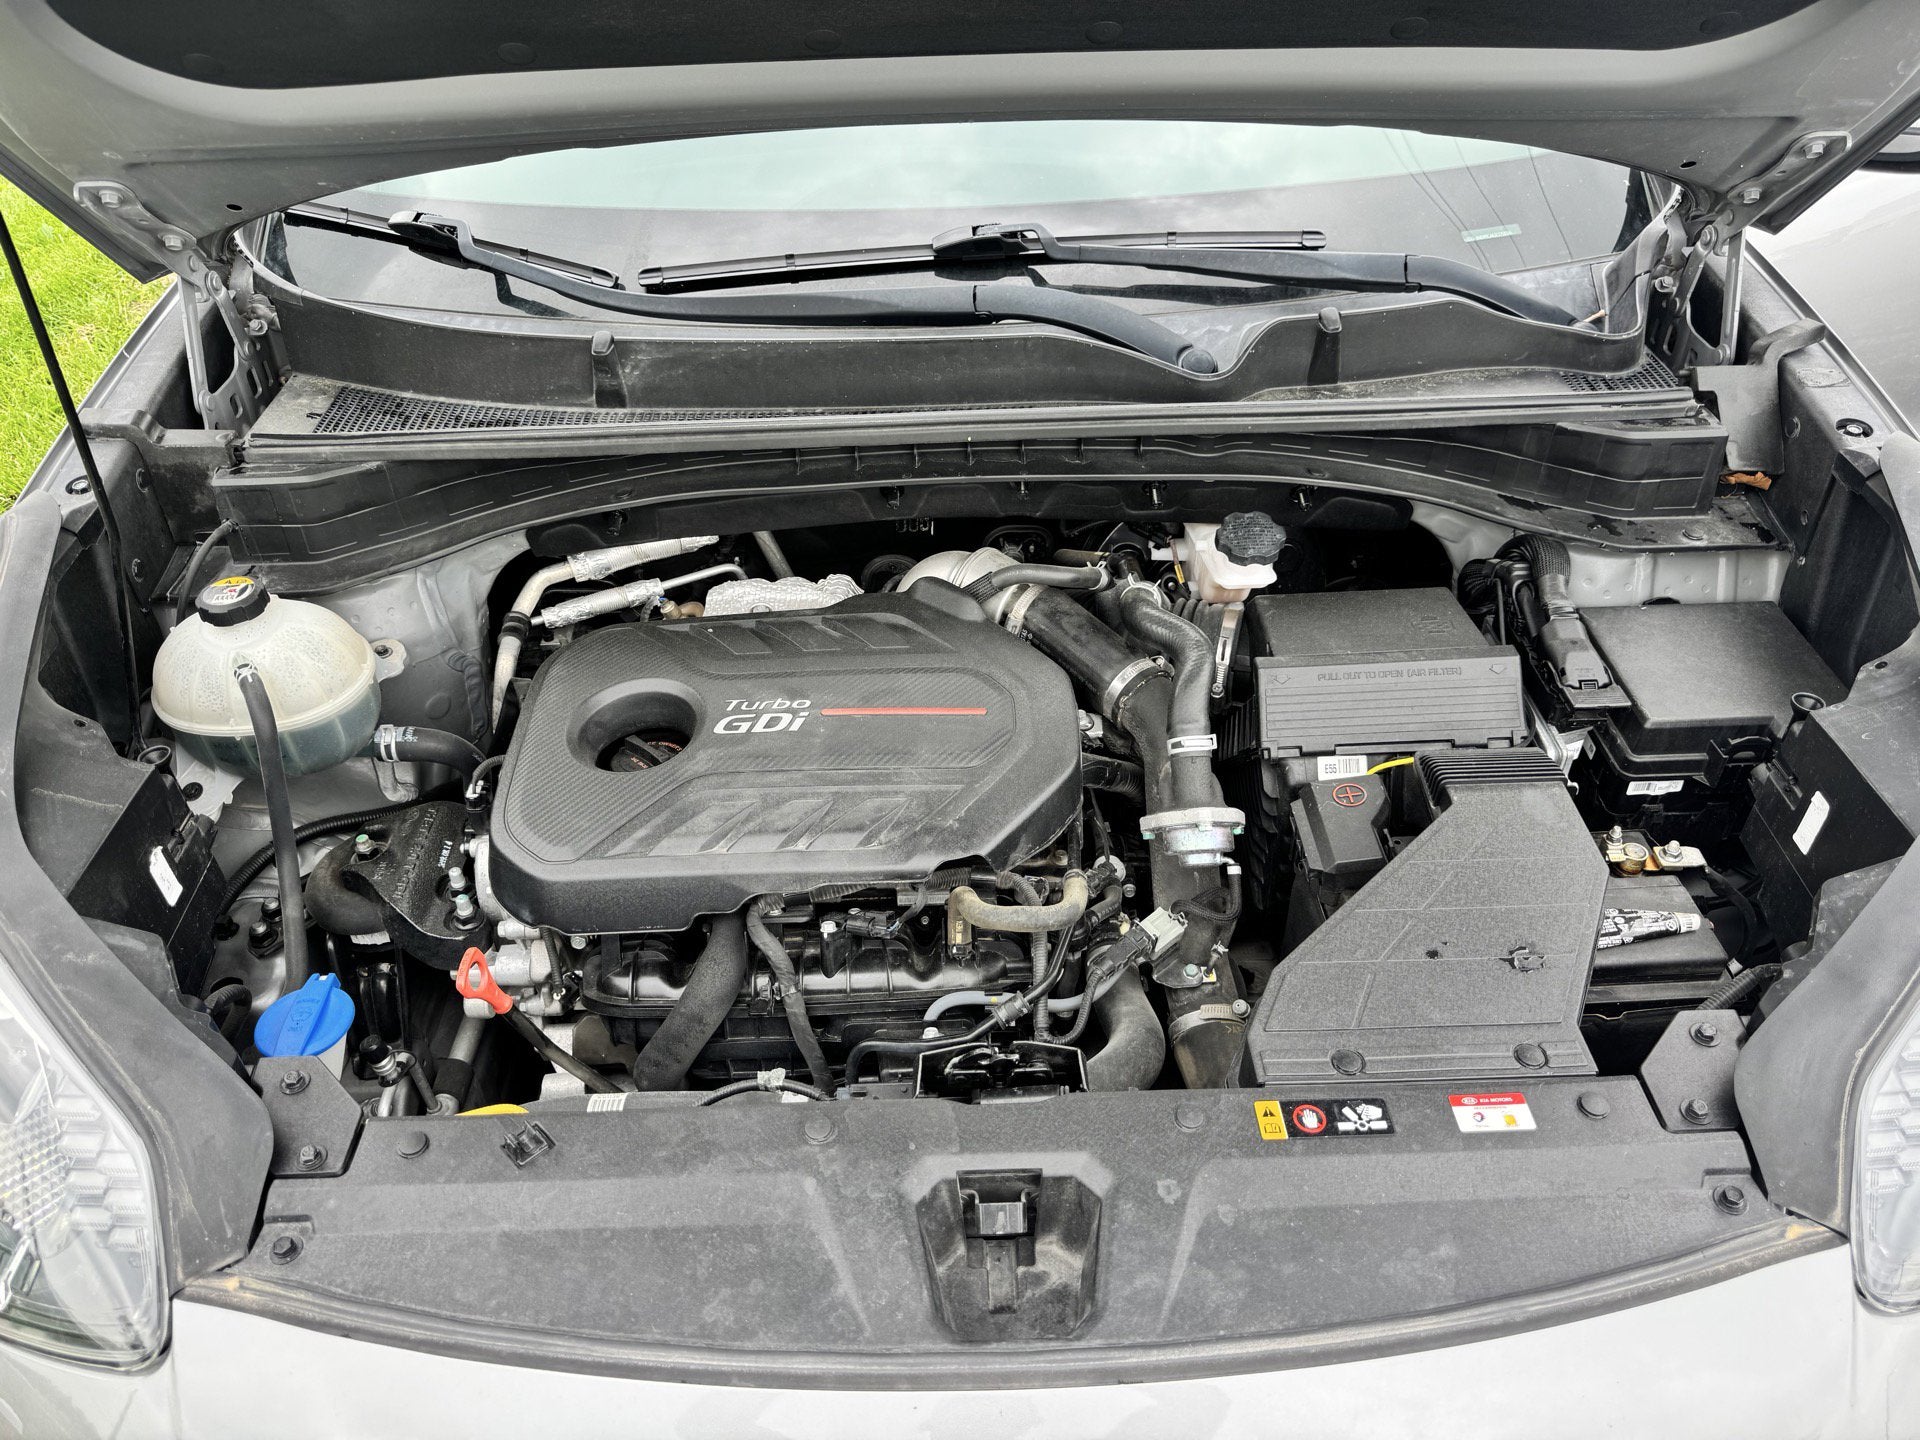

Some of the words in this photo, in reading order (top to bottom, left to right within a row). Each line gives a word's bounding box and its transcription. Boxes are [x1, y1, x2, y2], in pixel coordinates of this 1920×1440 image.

[1317, 672, 1342, 681] PULL
[1342, 671, 1361, 681] OUT
[1364, 671, 1377, 680] TO
[1378, 670, 1404, 679] OPEN
[1407, 668, 1426, 678] (AIR
[1428, 666, 1462, 677] FILTER)
[725, 697, 812, 712] Turbo
[713, 711, 810, 735] GDi
